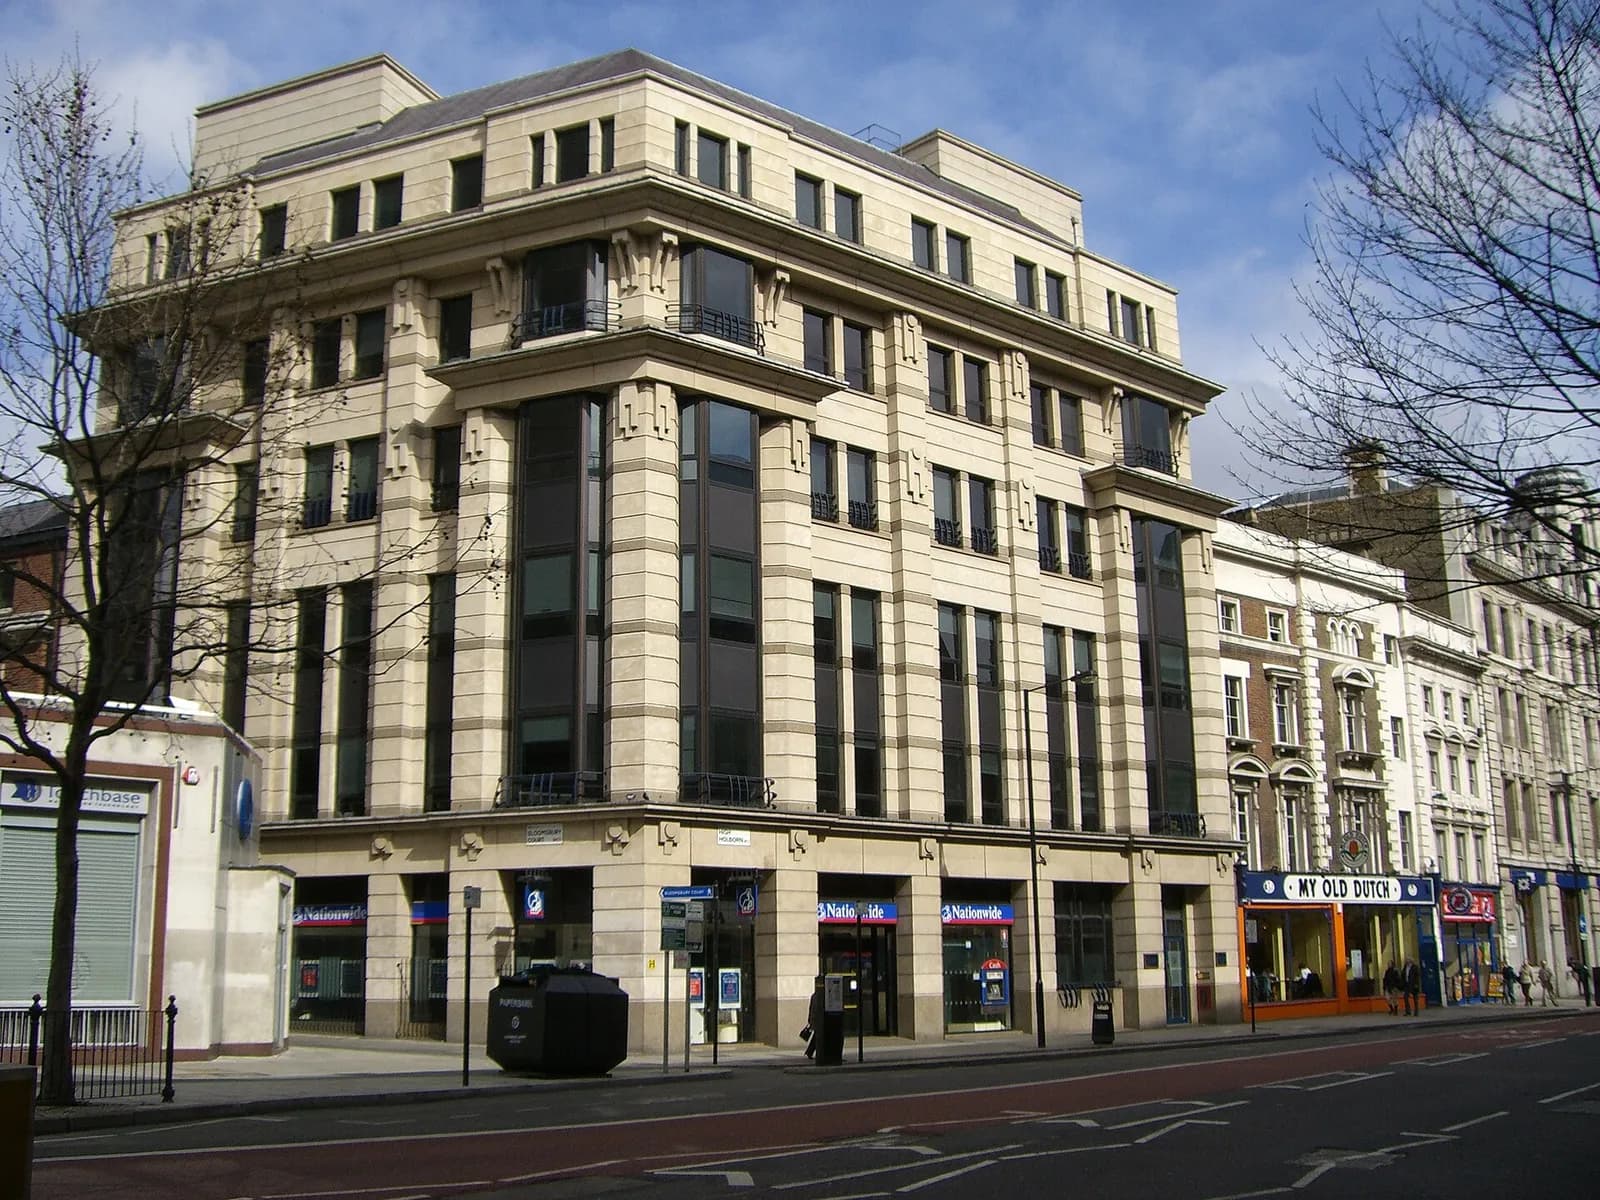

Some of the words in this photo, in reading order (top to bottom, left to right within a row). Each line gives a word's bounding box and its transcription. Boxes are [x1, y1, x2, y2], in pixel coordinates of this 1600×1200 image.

[48, 785, 141, 804] Tochbase
[1298, 878, 1316, 897] MY
[1322, 879, 1347, 897] OLD
[1354, 880, 1390, 898] DUTCH
[304, 905, 367, 920] Nationwide
[827, 903, 884, 919] Natioide
[952, 905, 1003, 919] Nationwide
